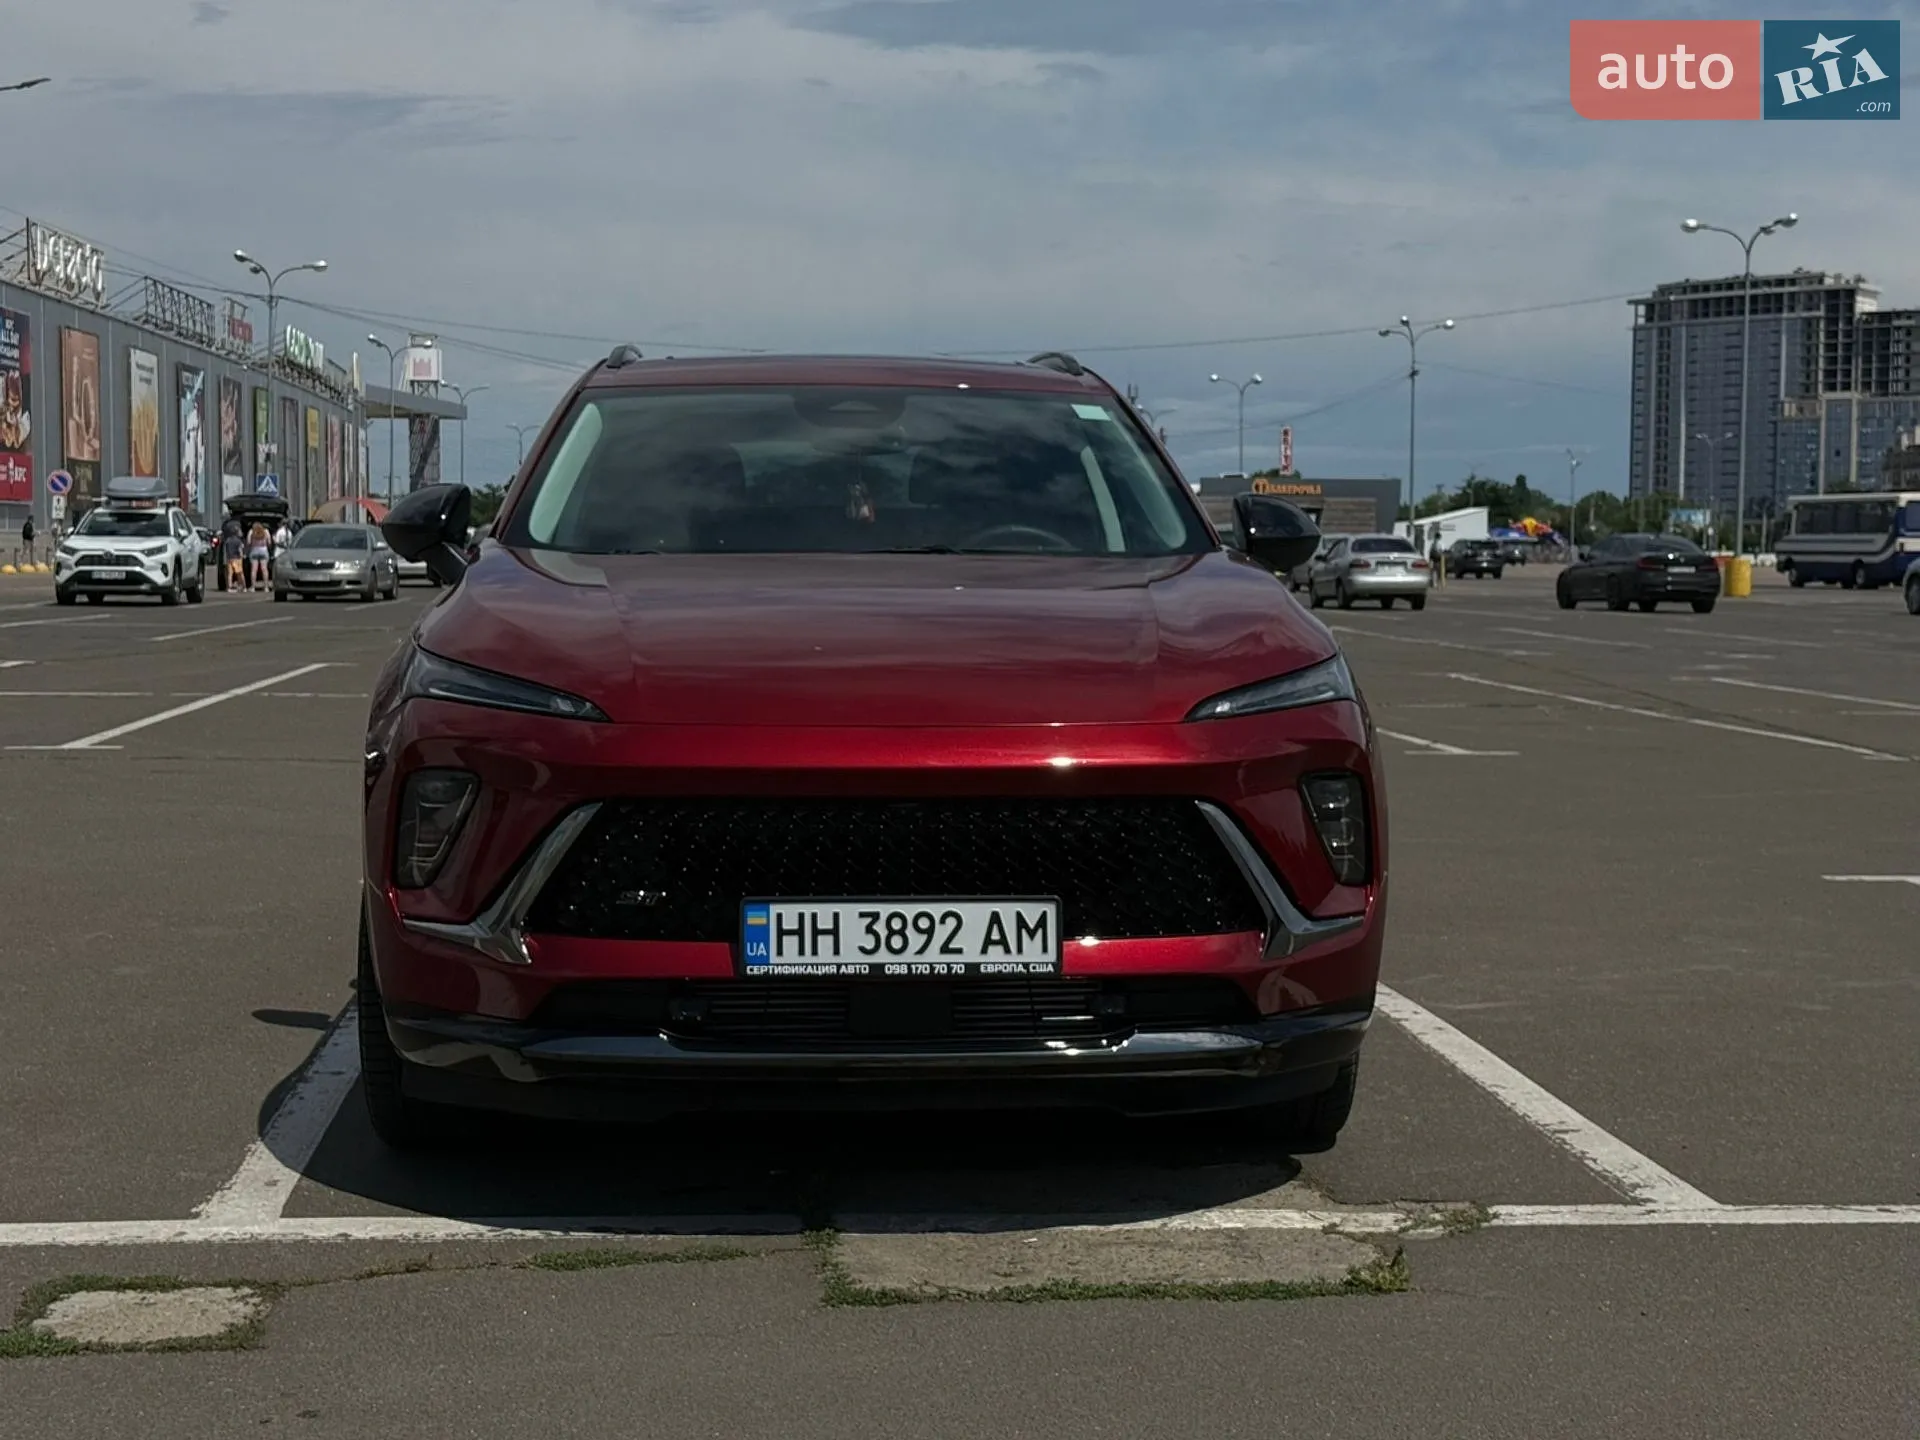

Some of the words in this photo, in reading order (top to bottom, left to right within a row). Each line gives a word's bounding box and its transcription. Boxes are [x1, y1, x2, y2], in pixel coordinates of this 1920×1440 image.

[776, 911, 840, 957] HH
[858, 910, 963, 955] 3892
[980, 910, 1048, 955] AM
[746, 942, 767, 957] UA
[746, 964, 837, 976] СЕРТИФИКАЦИЯ
[839, 963, 870, 975] АВТО
[884, 963, 908, 975] 098
[911, 963, 930, 975] 170
[932, 963, 947, 975] 70
[949, 963, 965, 975] 70
[1029, 962, 1055, 974] США
